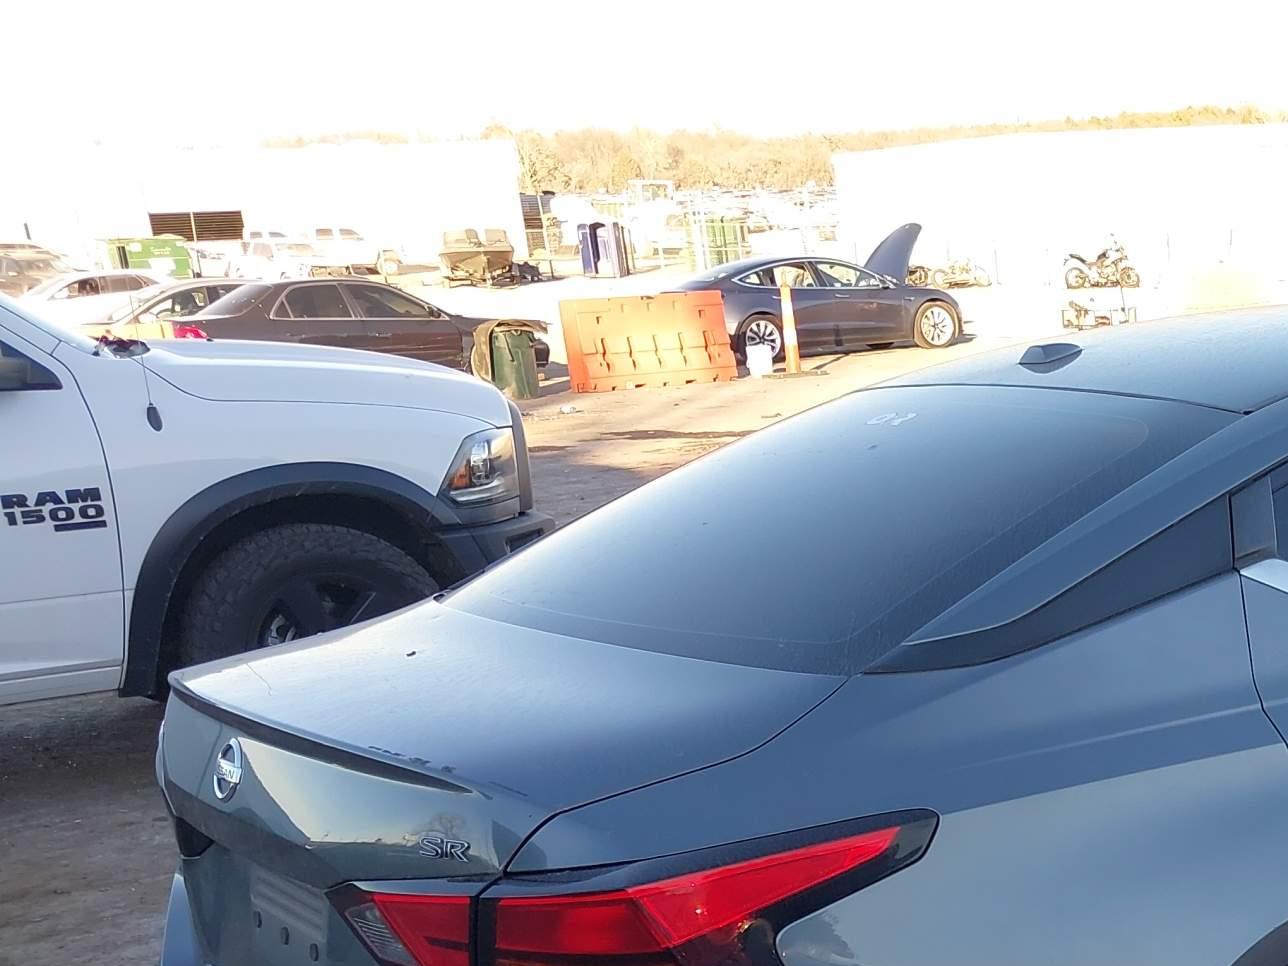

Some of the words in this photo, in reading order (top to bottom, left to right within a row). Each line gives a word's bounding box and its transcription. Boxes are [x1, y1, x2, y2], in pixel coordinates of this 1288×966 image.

[0, 487, 102, 510] RAM
[3, 504, 105, 526] 1500
[419, 836, 470, 863] SR
